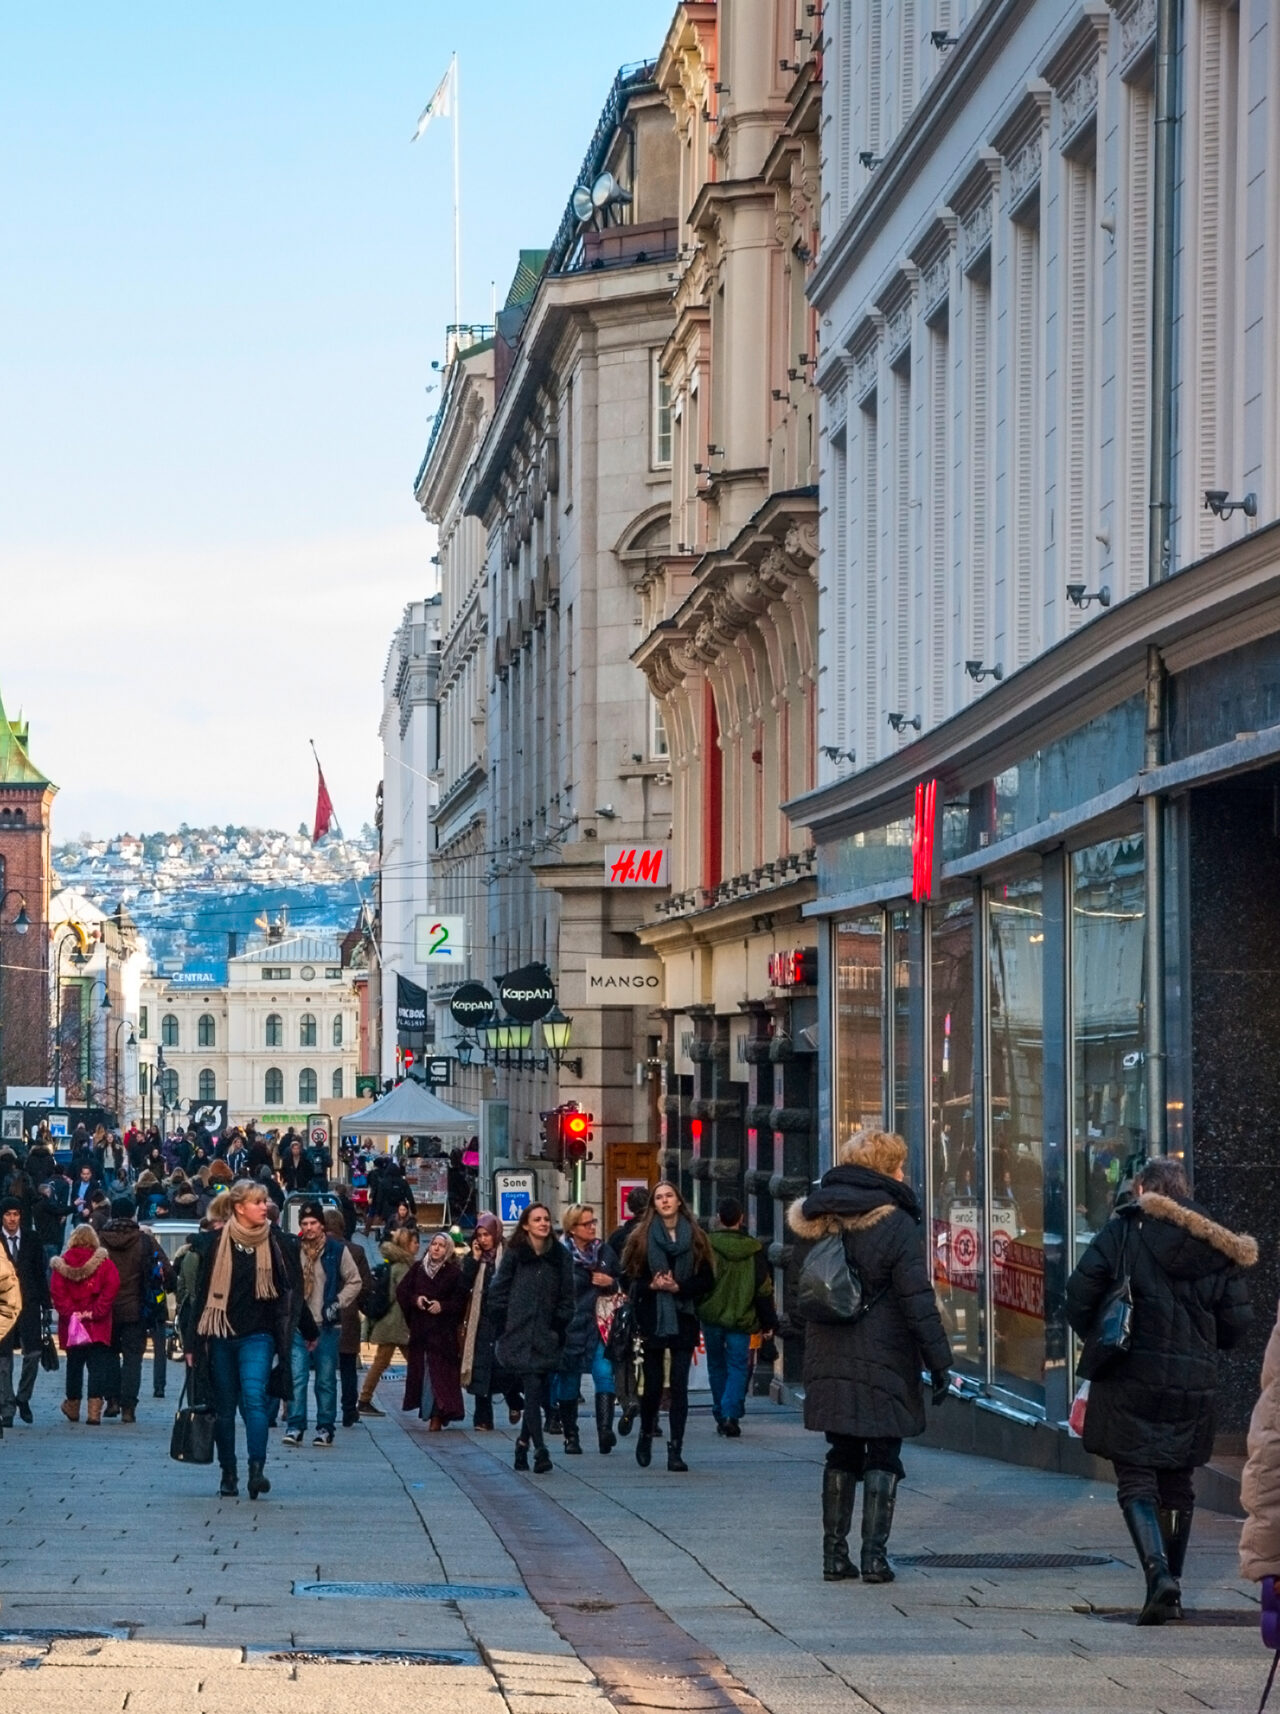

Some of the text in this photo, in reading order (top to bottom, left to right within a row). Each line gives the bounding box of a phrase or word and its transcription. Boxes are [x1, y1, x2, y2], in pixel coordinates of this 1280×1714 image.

[610, 849, 663, 884] H&M
[172, 972, 215, 982] CENTRAL
[590, 975, 659, 988] MANGO
[502, 987, 552, 1001] KappAhl
[452, 1000, 492, 1011] KappAhl
[314, 1132, 324, 1140] 30
[503, 1178, 527, 1187] Sone
